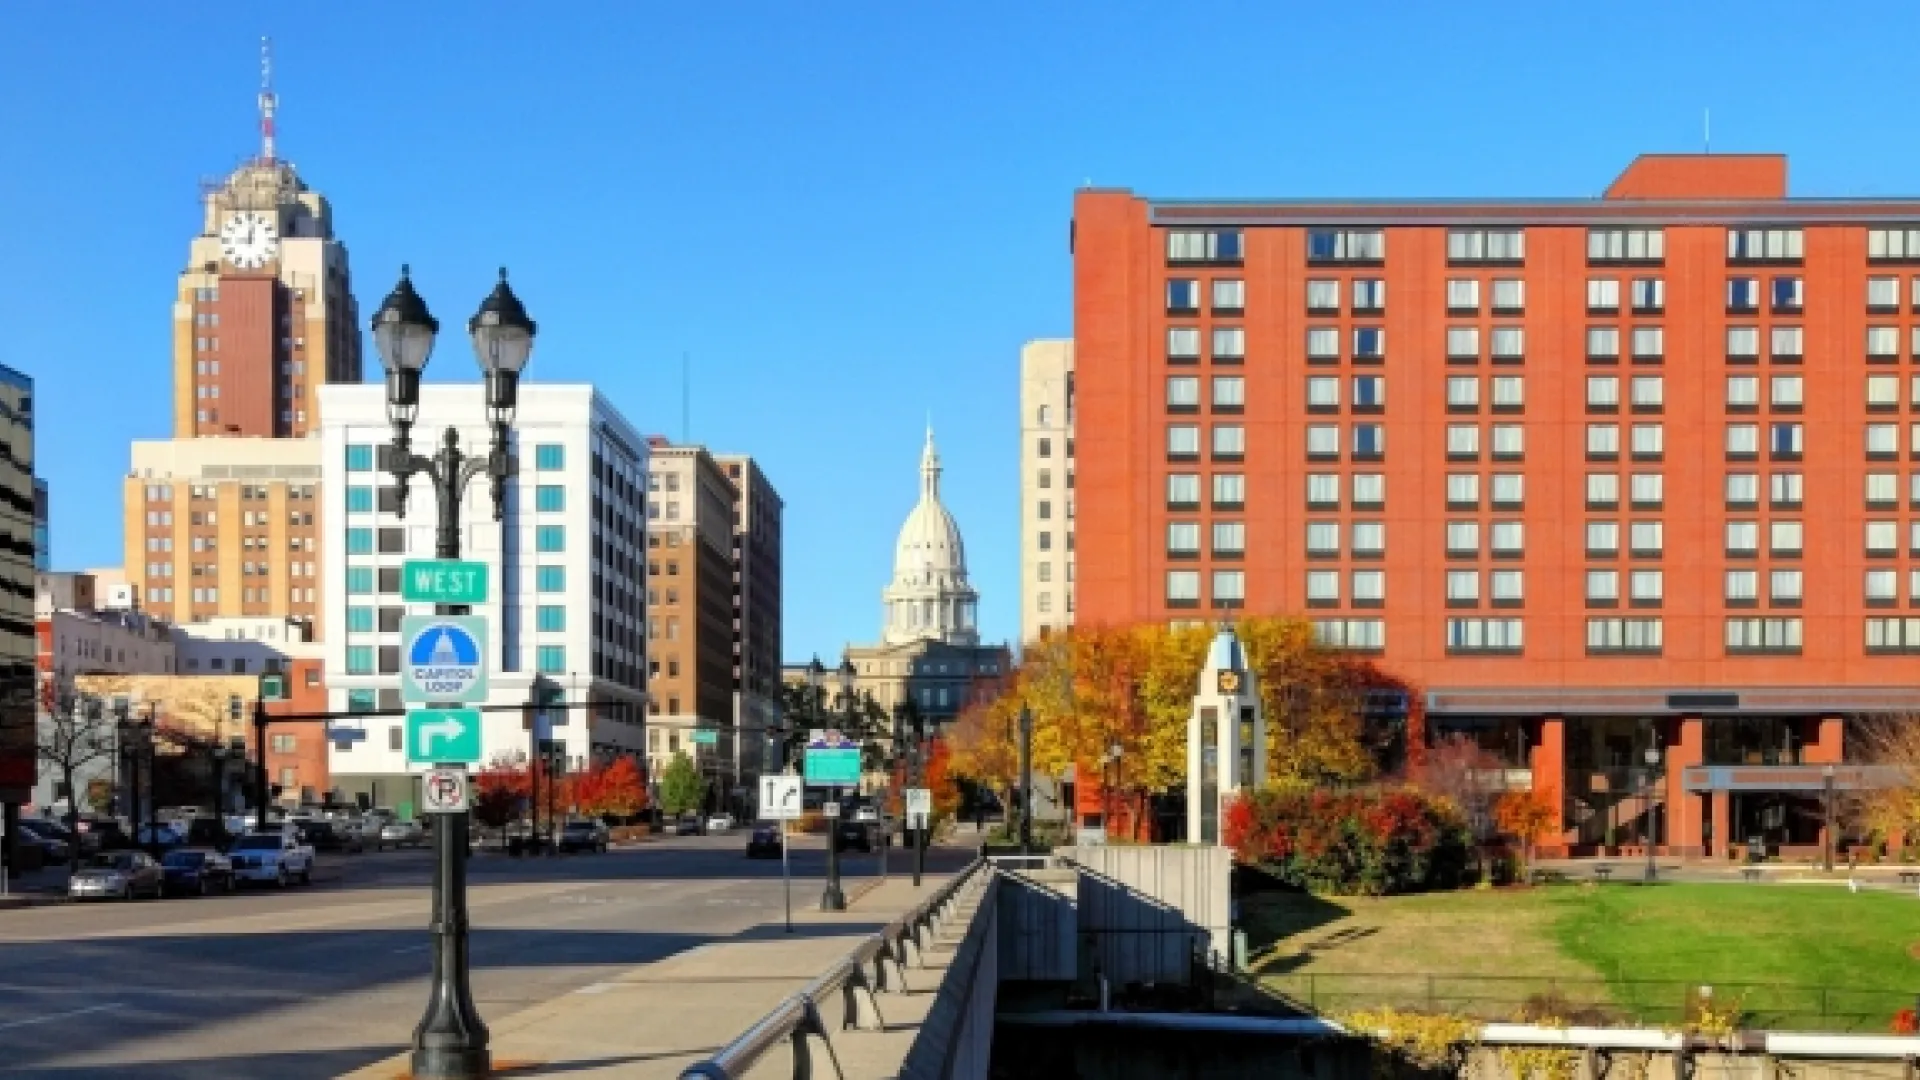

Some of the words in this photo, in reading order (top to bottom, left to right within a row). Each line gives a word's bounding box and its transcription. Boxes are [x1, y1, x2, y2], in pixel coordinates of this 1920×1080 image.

[414, 569, 477, 594] WEST
[414, 668, 475, 680] CAPITOL
[425, 681, 463, 693] LOOP
